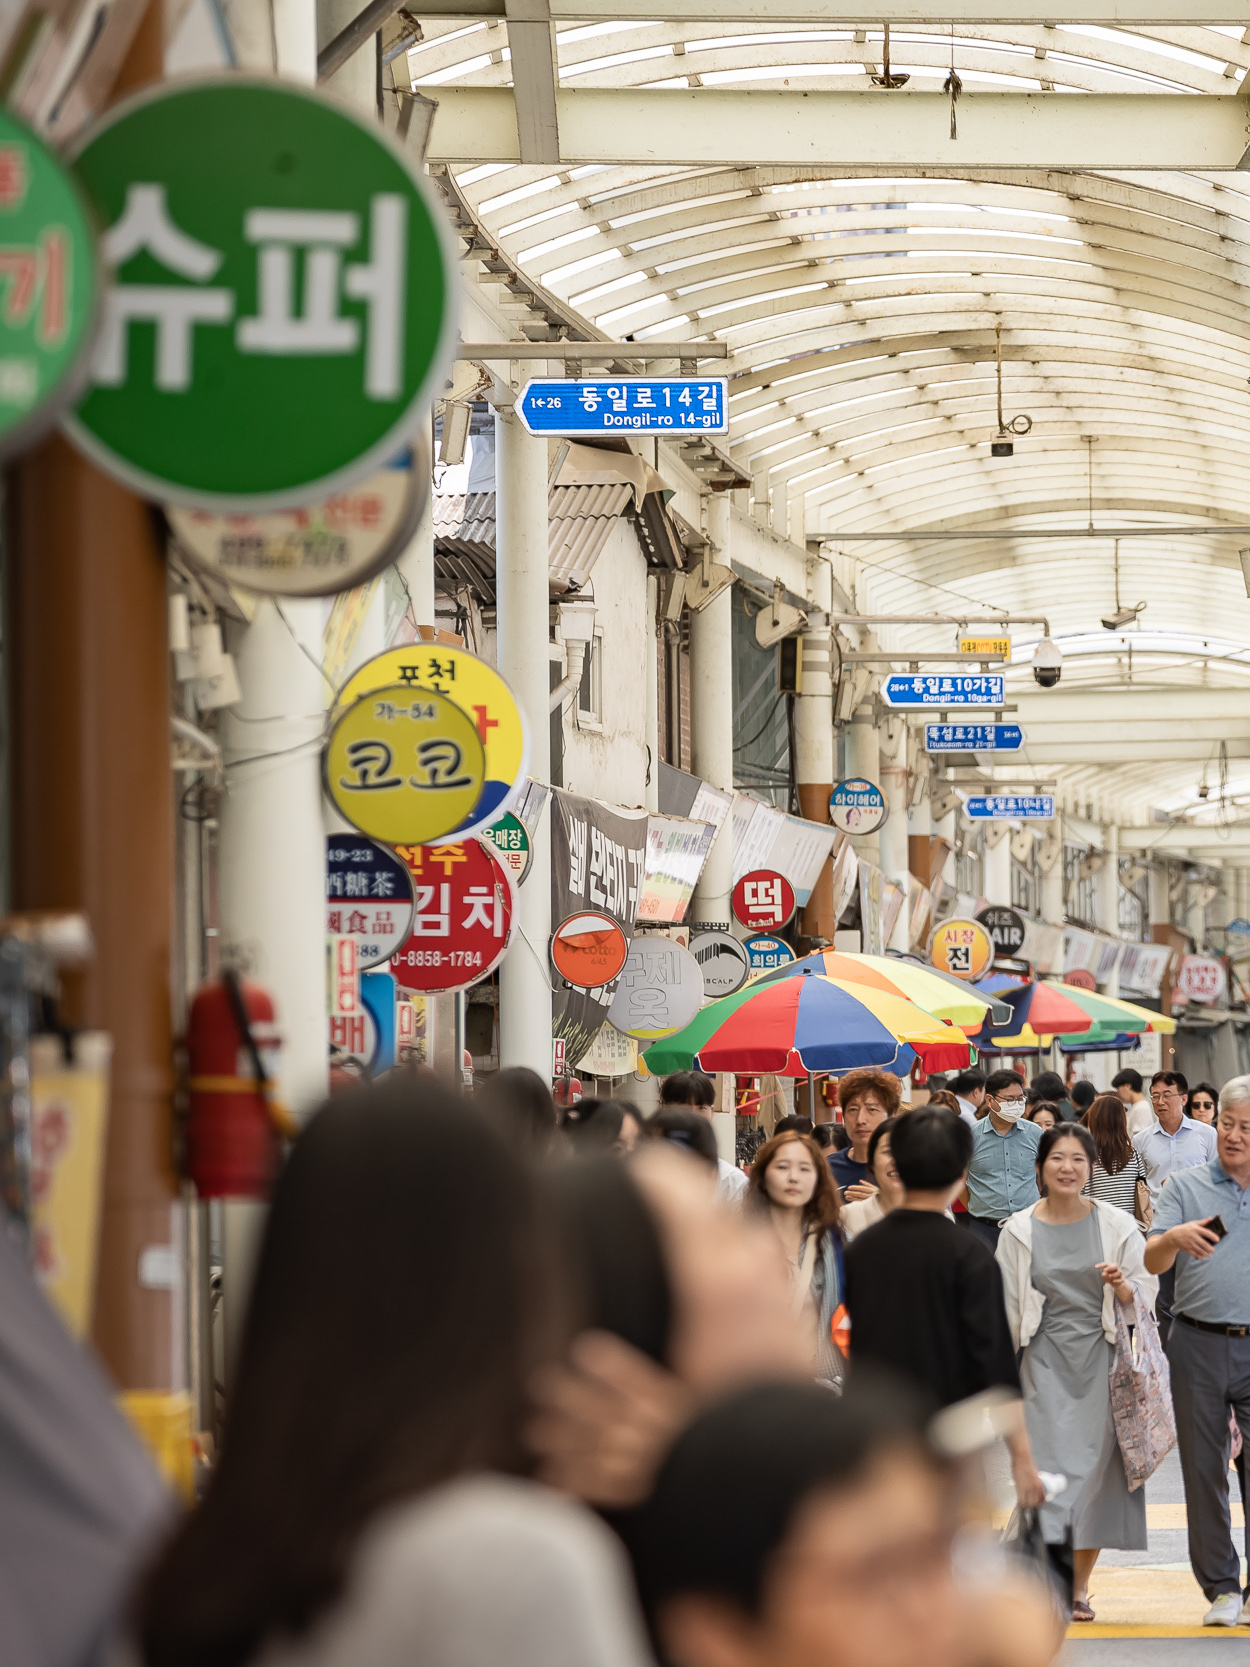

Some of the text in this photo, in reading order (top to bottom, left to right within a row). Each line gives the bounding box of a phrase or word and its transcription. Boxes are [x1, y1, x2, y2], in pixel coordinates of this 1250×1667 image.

[90, 182, 410, 402] 슈퍼
[546, 398, 562, 409] 26
[578, 385, 718, 412] 동일로14길
[603, 412, 720, 428] Dongil-ro 14-gil
[911, 677, 1001, 695] 동일로10가길
[922, 693, 965, 703] Dongil-ro
[374, 702, 436, 720] 가-54
[340, 740, 473, 790] 코코
[835, 793, 881, 807] 하이헤어
[413, 882, 504, 938] 김치
[743, 878, 783, 922] 떡
[943, 928, 975, 944] 시장
[621, 950, 682, 988] 구제
[947, 946, 971, 972] 전
[628, 987, 670, 1030] 옷
